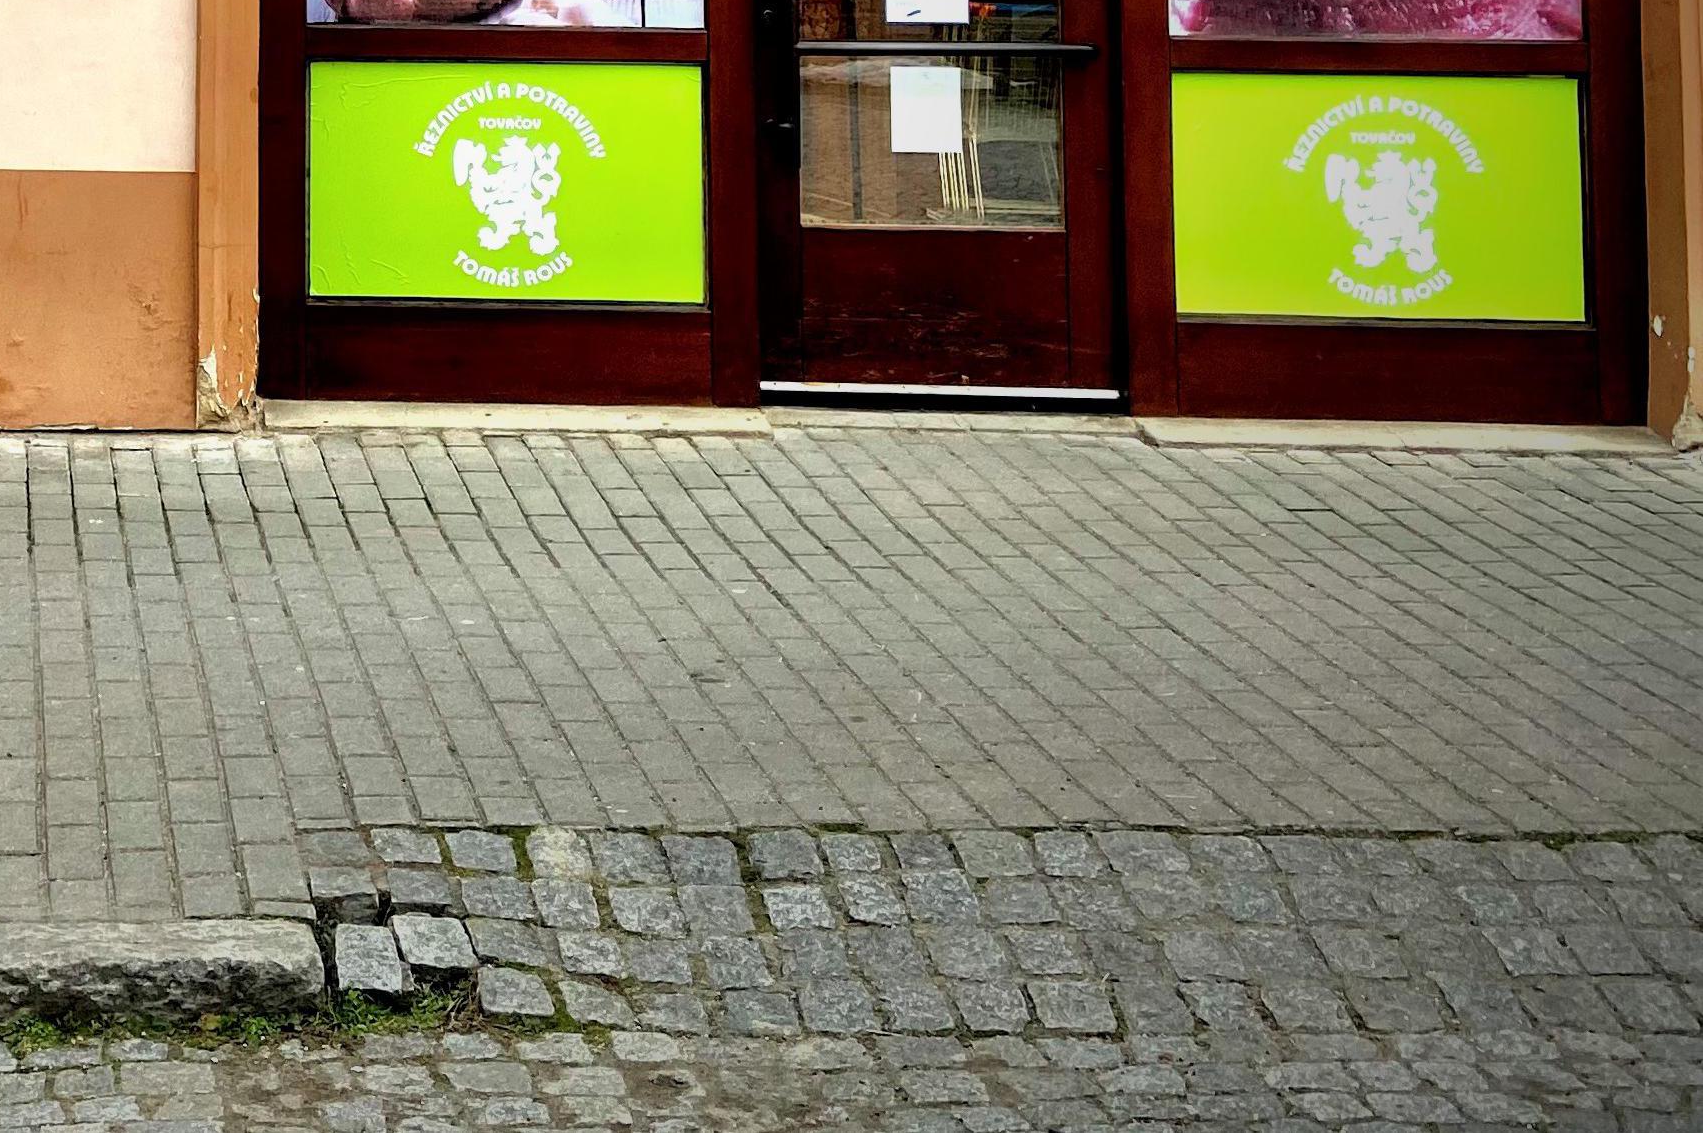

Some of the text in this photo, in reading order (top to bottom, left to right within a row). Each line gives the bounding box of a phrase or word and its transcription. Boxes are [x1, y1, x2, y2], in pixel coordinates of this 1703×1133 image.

[497, 83, 511, 99] A
[516, 83, 607, 159] POTRAVINY
[1369, 97, 1383, 113] A
[1388, 97, 1484, 173] POTRAVINY
[524, 252, 573, 286] ROUS
[1402, 270, 1452, 304] ROUS
